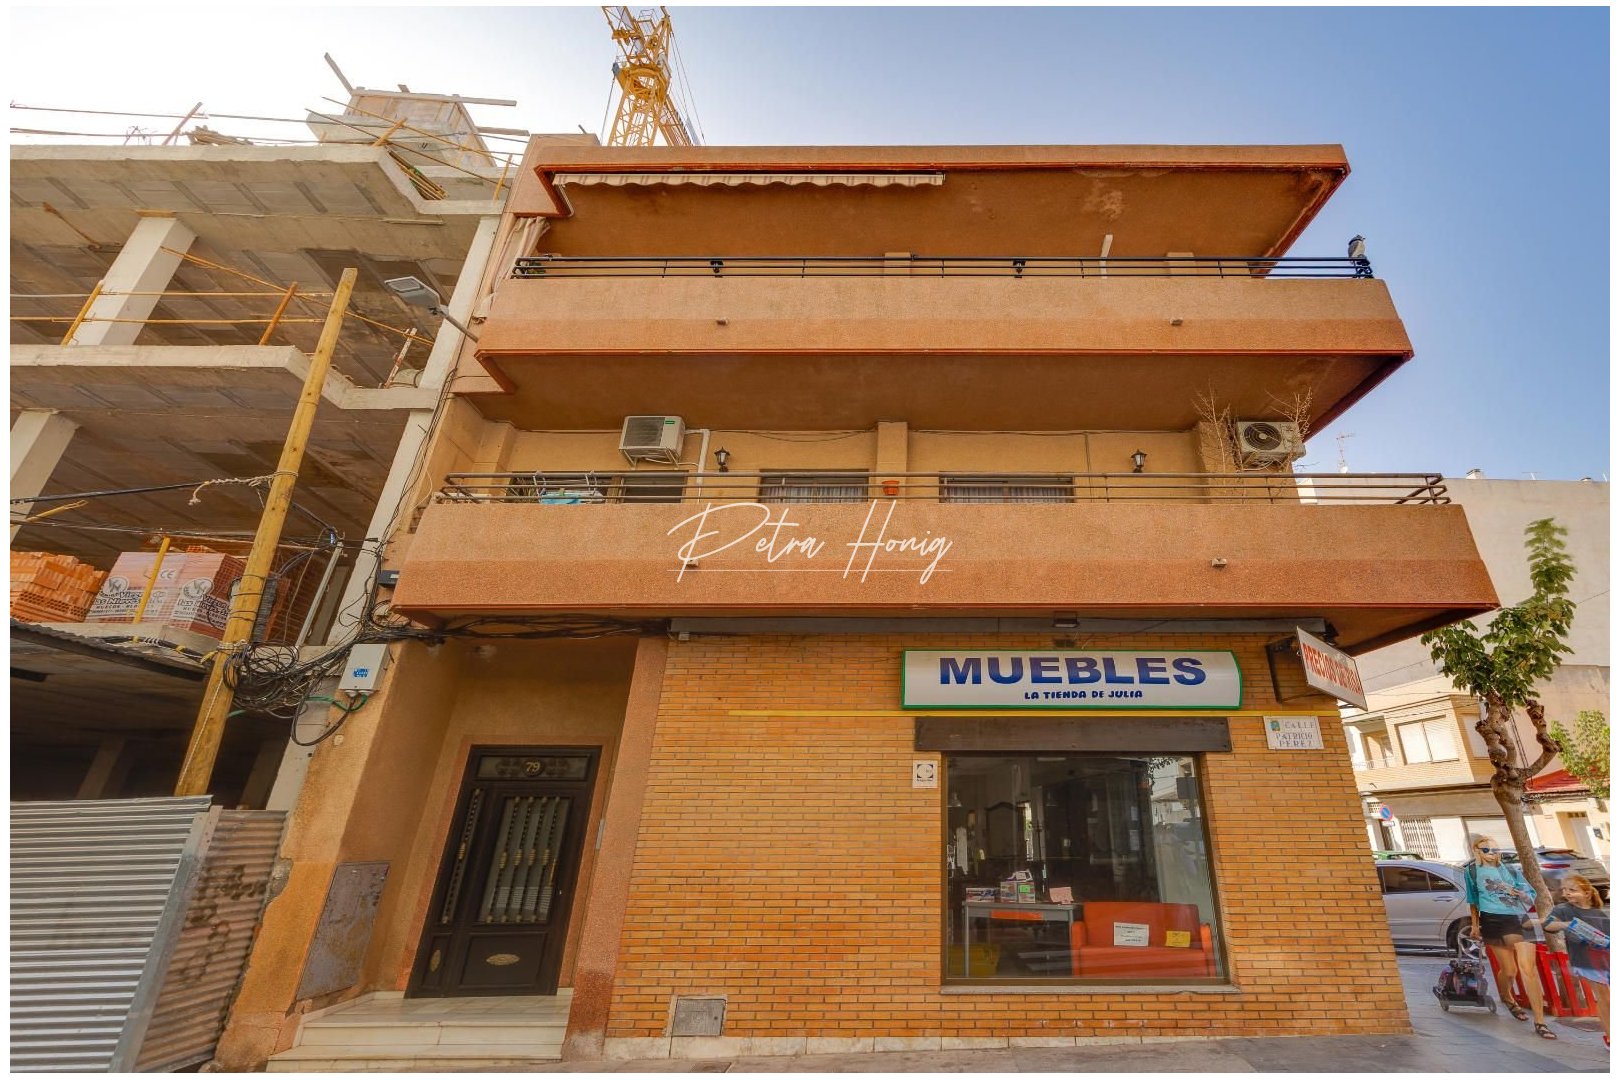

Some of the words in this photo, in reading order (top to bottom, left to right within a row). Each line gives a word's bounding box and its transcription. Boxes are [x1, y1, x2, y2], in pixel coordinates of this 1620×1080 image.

[939, 656, 1206, 686] MUEBLES
[1024, 691, 1040, 700] LA
[1043, 690, 1087, 699] TIENDA
[1091, 690, 1105, 699] DE
[1108, 690, 1144, 698] JULIA
[1284, 721, 1315, 729] CALLE
[1275, 731, 1313, 739] PATRICIO
[525, 761, 541, 773] 79
